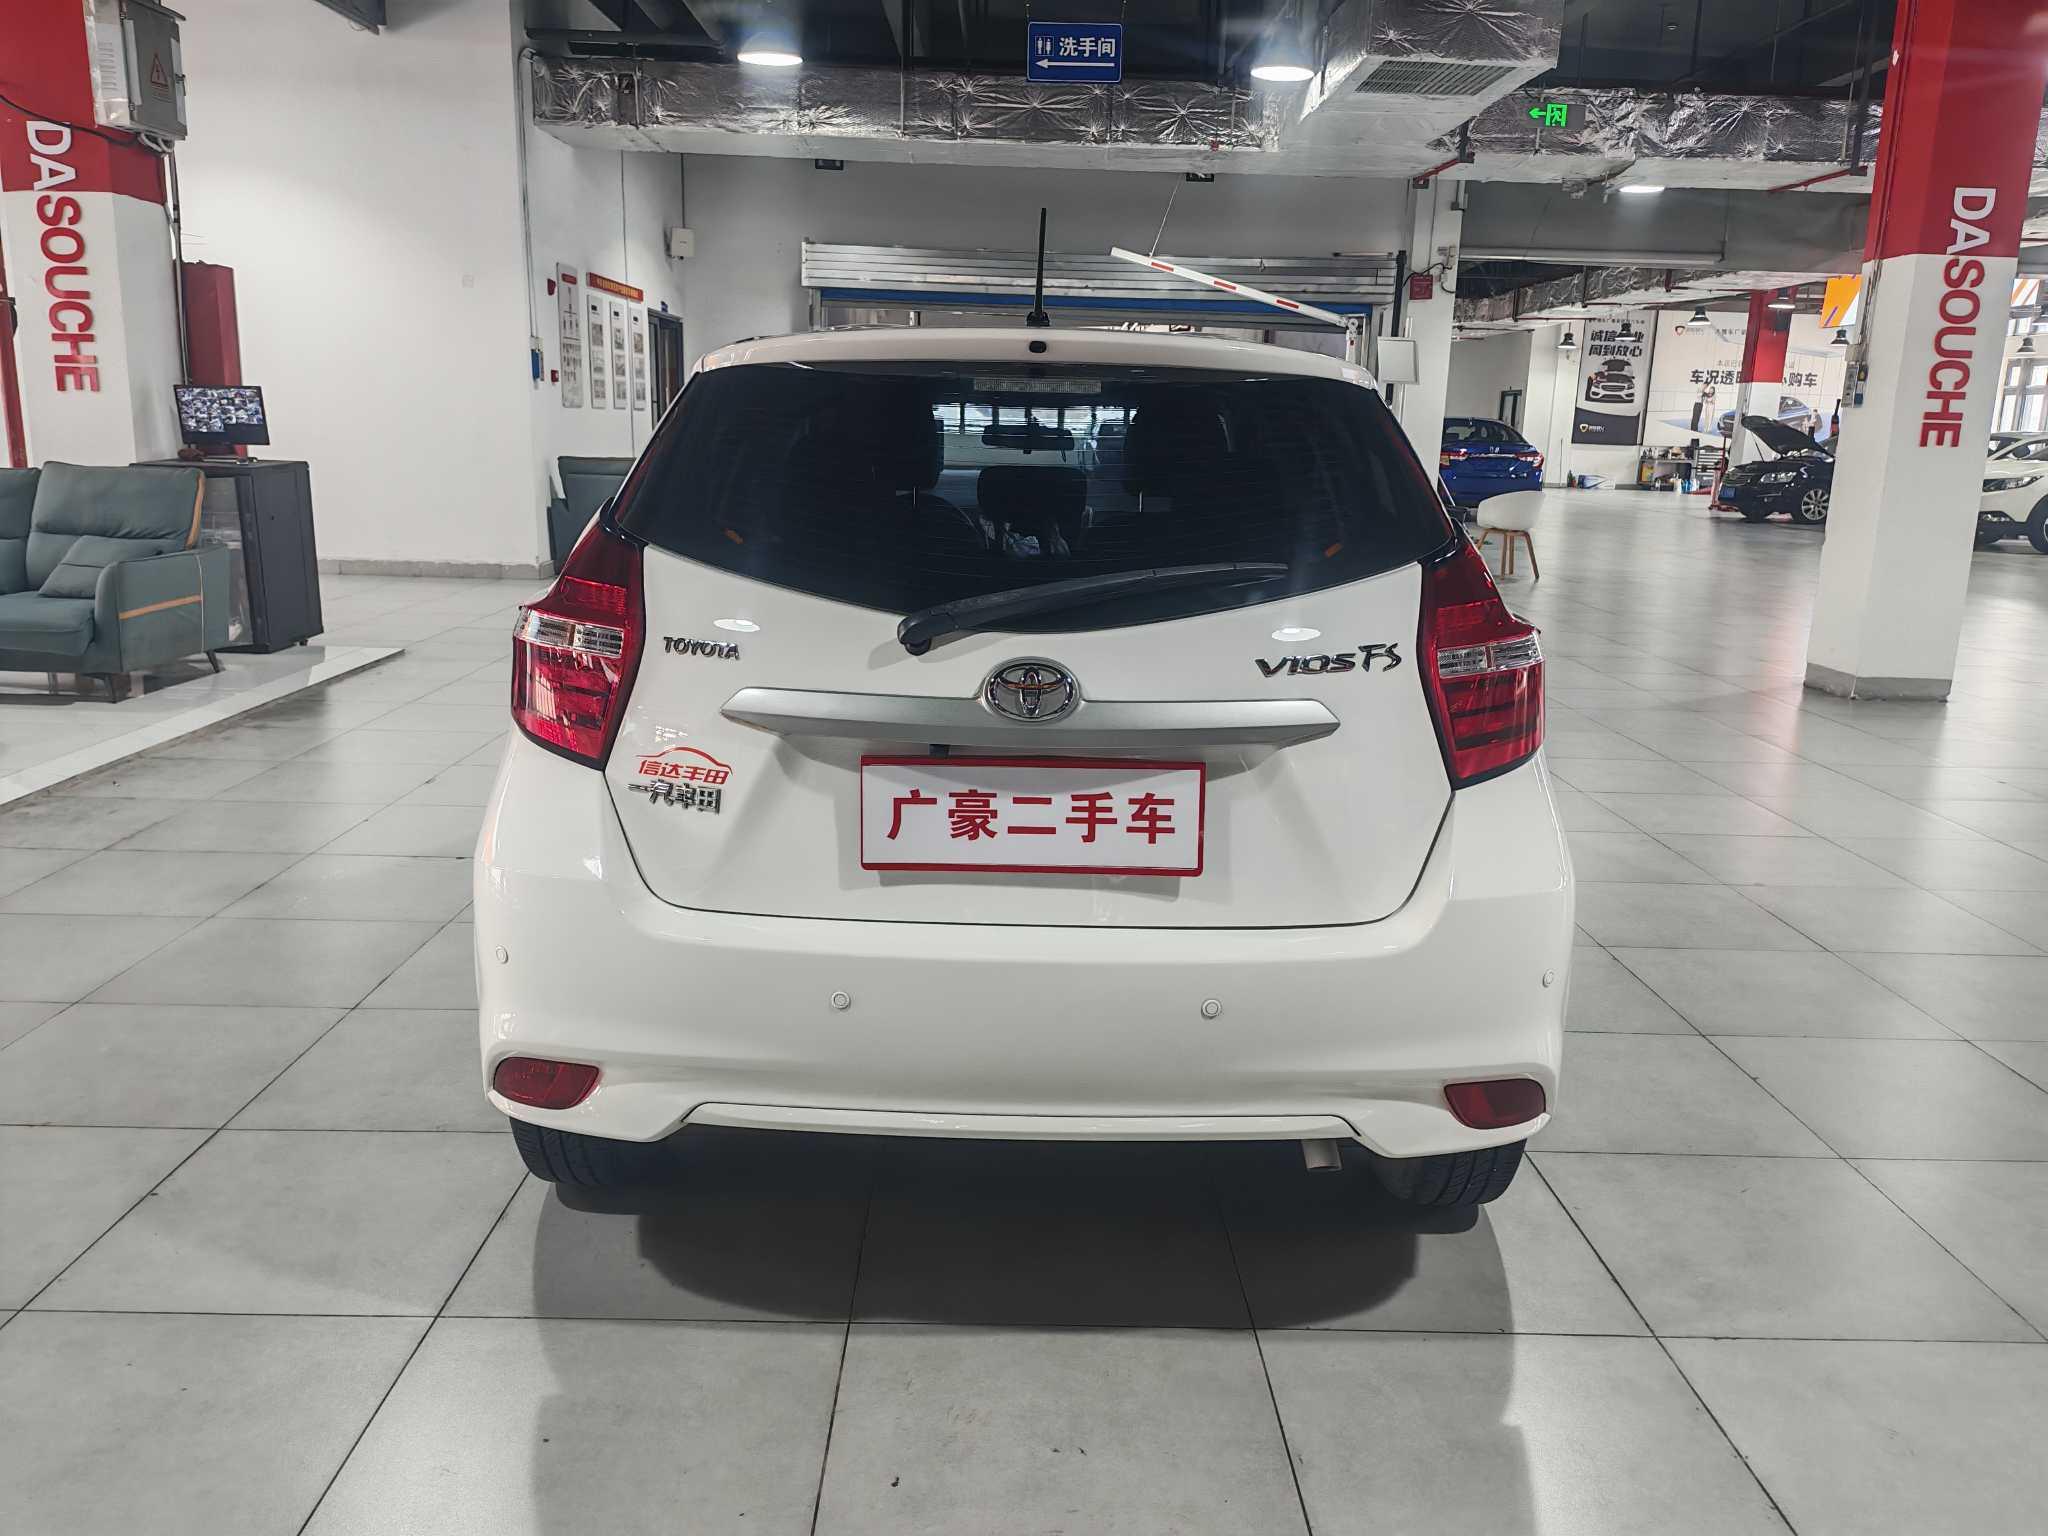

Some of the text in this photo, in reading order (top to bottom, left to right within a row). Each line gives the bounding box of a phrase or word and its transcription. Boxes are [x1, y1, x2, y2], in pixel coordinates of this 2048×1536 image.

[1059, 37, 1116, 57] 洗手间
[26, 120, 101, 392] DASOUCHE
[1919, 187, 1997, 448] DASOUCHE
[1590, 330, 1645, 343] 诚信业
[663, 636, 740, 660] TOYOTA
[1255, 642, 1402, 678] VIOS FS
[638, 759, 730, 785] 信达丰田
[886, 789, 1176, 845] 广豪二手车
